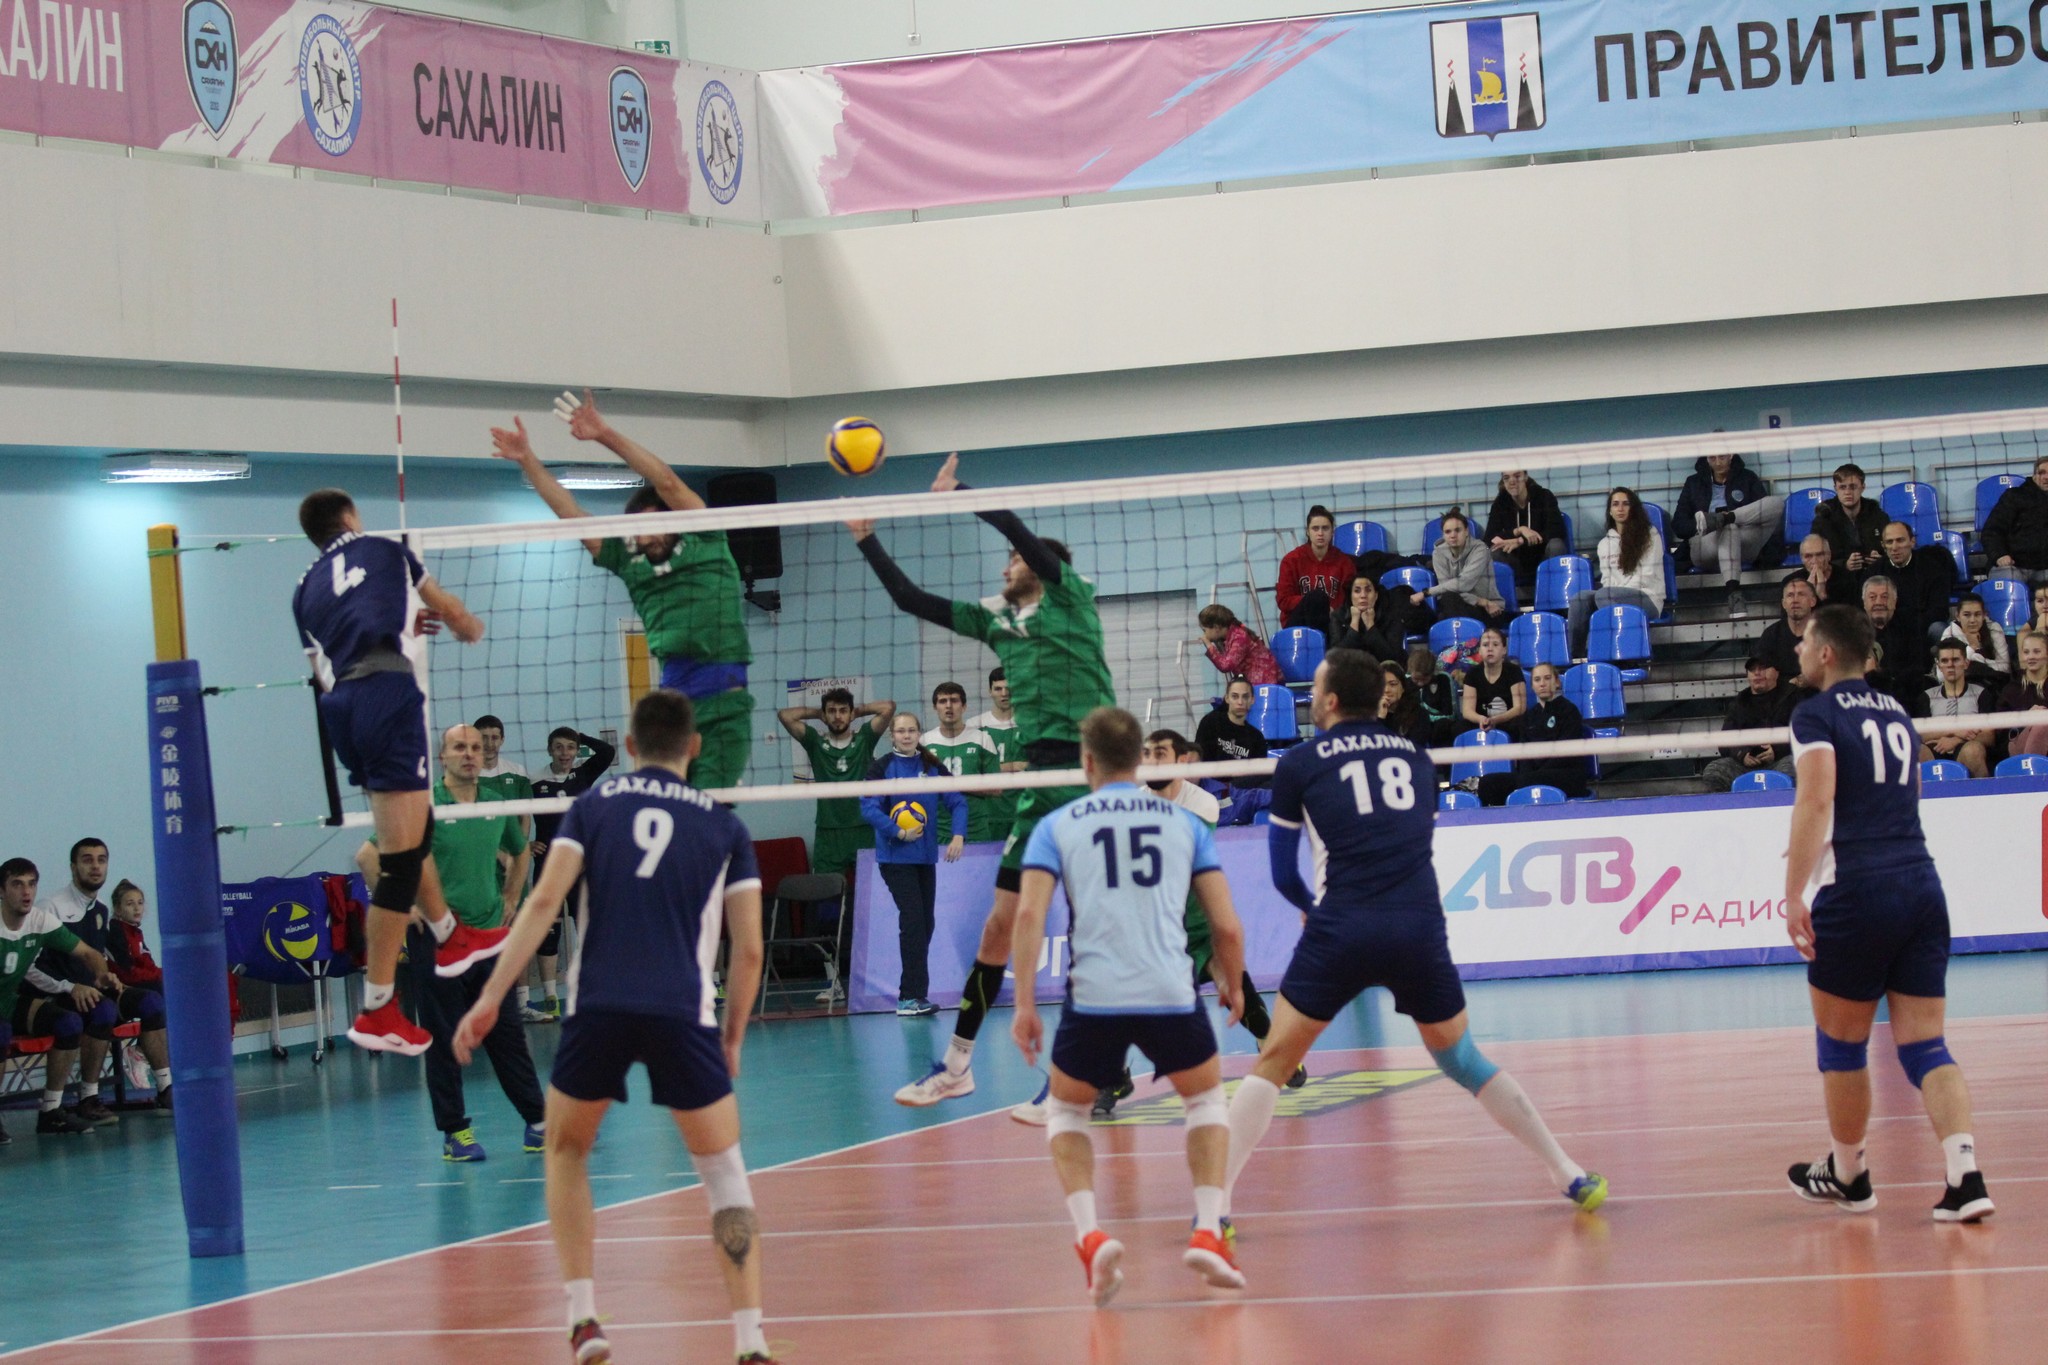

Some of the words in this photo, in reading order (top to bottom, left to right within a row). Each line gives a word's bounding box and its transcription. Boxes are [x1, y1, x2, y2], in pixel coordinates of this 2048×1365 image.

[0, 0, 123, 92] АЛИН
[413, 62, 566, 153] САХАЛИН
[315, 127, 353, 154] САХАЛИН
[1299, 574, 1340, 600] GAP
[1316, 733, 1417, 759] САХАЛИН
[1861, 719, 1912, 786] 19
[601, 776, 714, 812] САХАЛИН
[1338, 757, 1416, 816] 18
[1071, 798, 1174, 819] САХАЛИН
[632, 806, 675, 879] 9
[1091, 824, 1163, 889] 15
[222, 892, 253, 901] OLLEYBALL
[4, 951, 19, 974] 9
